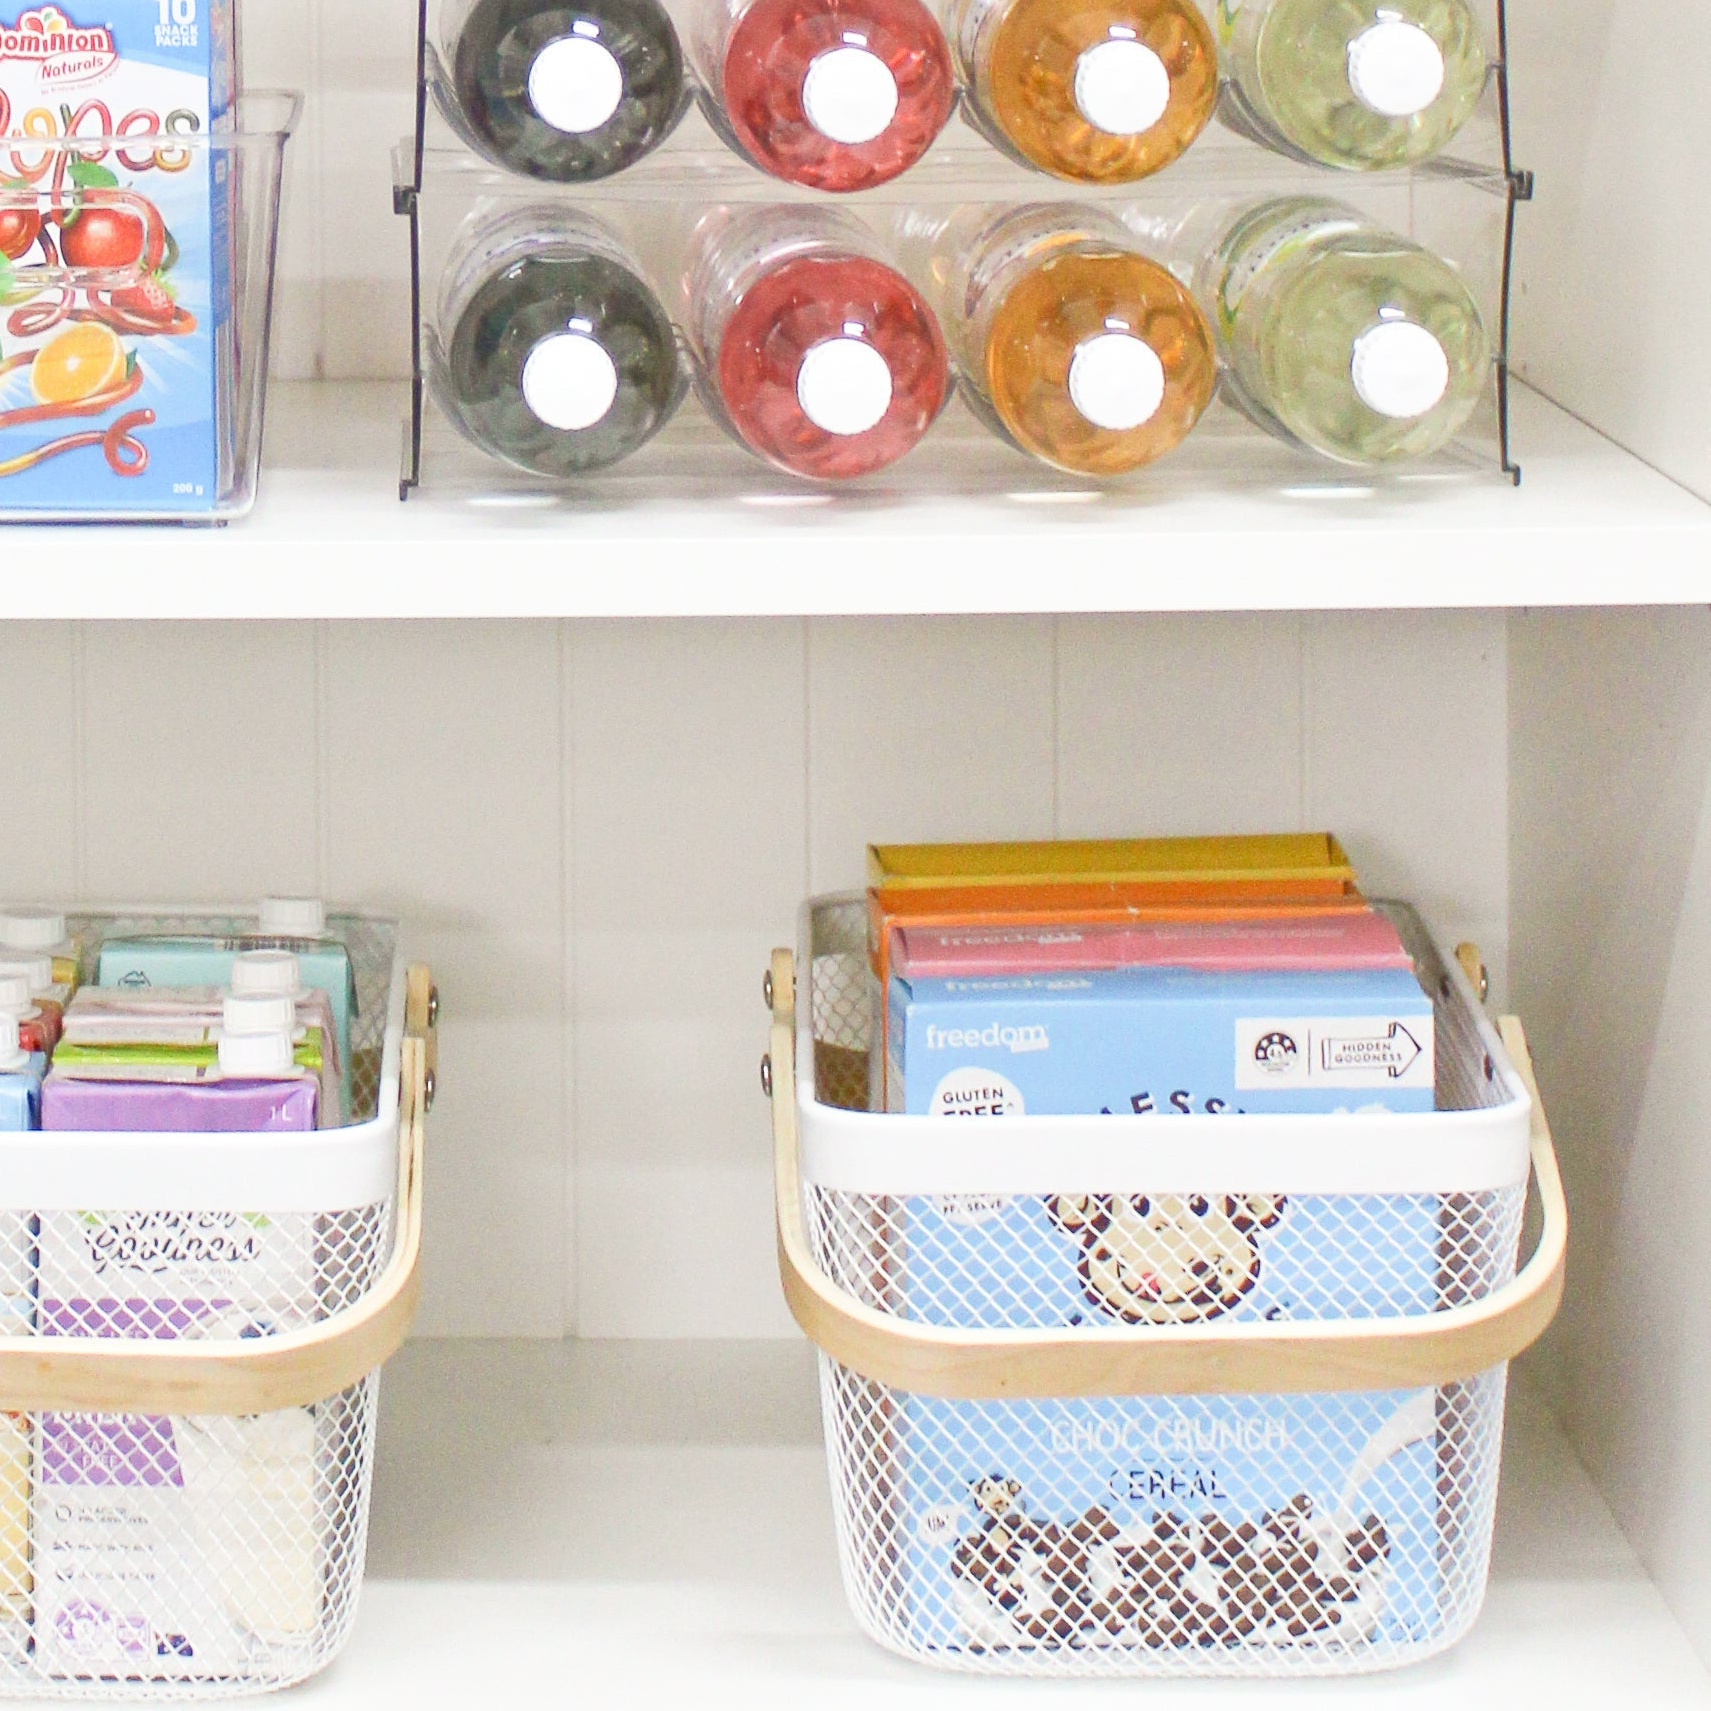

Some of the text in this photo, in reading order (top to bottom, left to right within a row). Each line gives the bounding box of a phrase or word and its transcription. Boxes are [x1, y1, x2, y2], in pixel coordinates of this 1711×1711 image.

[154, 25, 198, 37] SNACK
[155, 36, 198, 47] PACKS
[41, 57, 104, 80] Naturals
[172, 482, 205, 497] 200 g
[925, 1023, 1048, 1049] freedom
[1342, 1042, 1392, 1053] HIDDEN
[1334, 1053, 1402, 1064] GOODNESS
[943, 1087, 1005, 1104] GLUTEN
[1109, 1468, 1228, 1502] CEREAL
